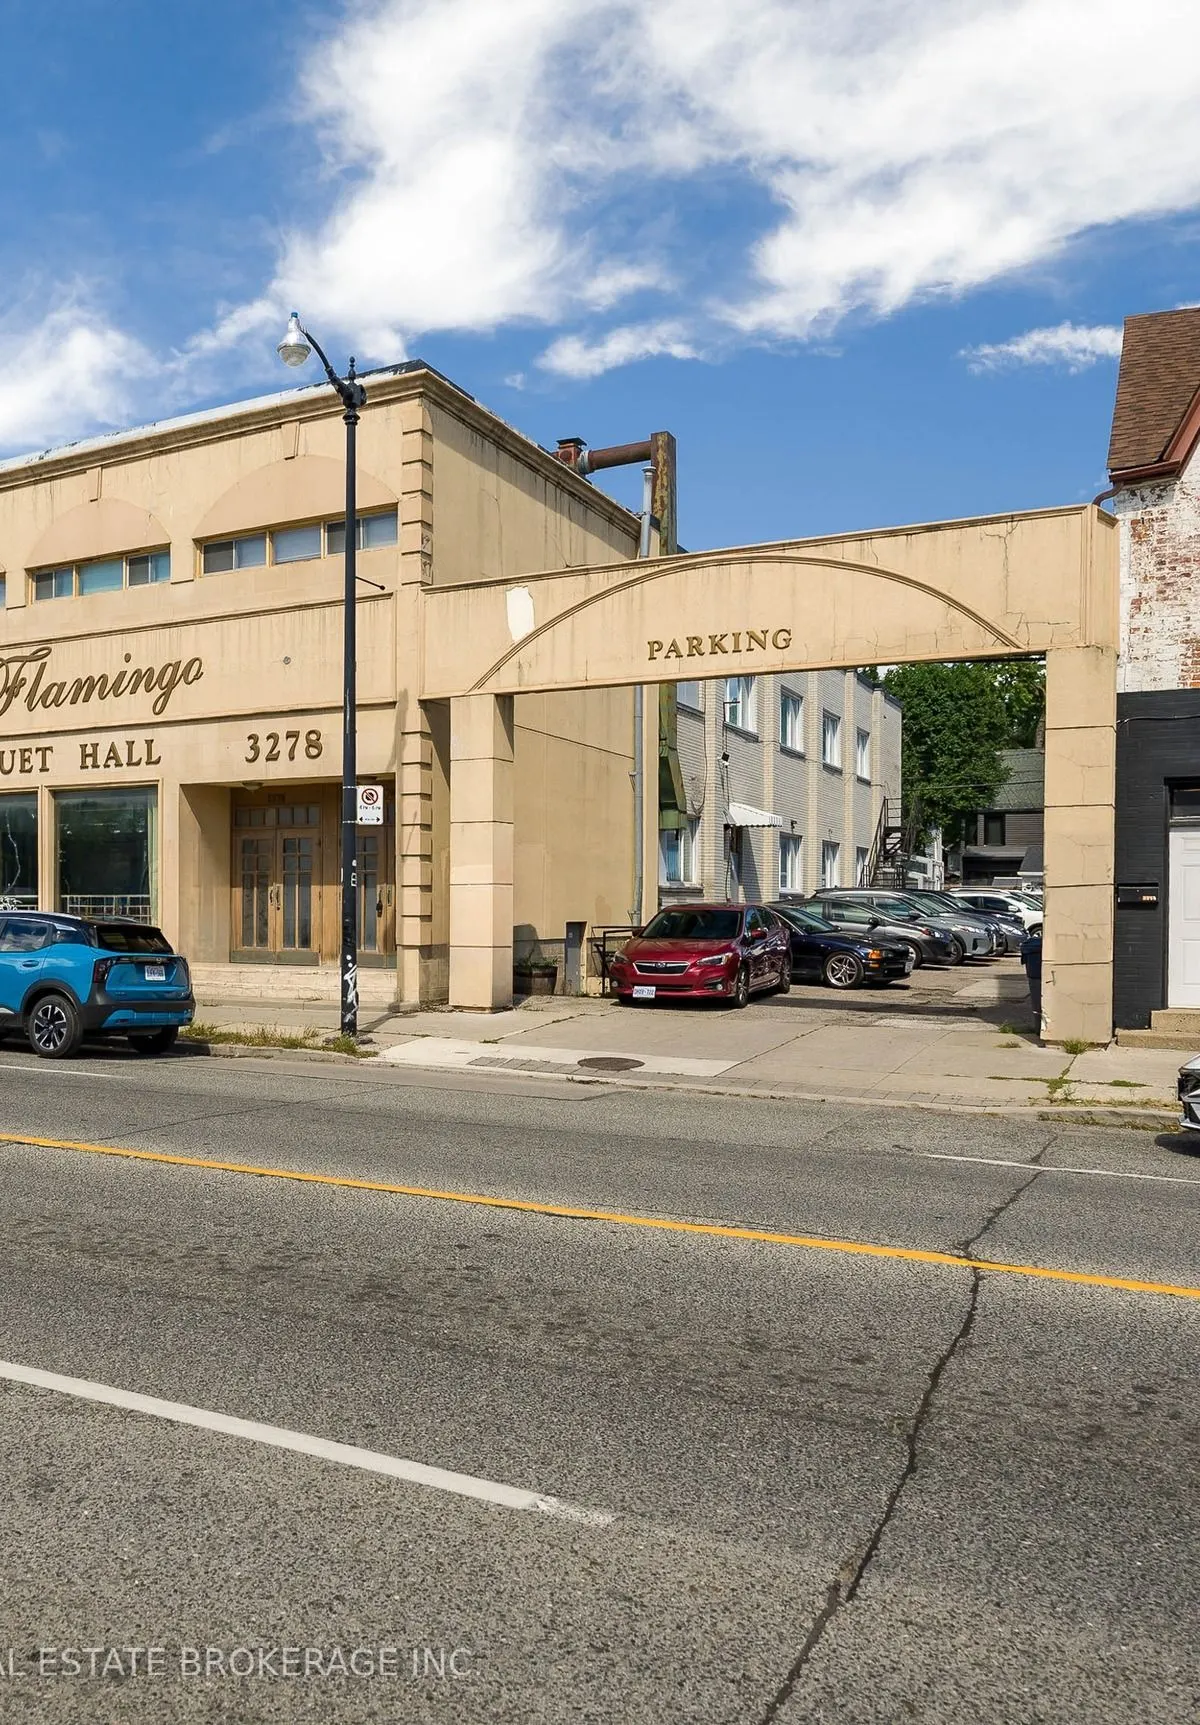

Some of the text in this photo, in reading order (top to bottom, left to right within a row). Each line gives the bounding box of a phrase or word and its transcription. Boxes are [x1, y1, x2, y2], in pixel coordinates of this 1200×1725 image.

[647, 628, 793, 661] PARKING
[79, 739, 162, 770] HALL
[245, 729, 323, 763] 3278
